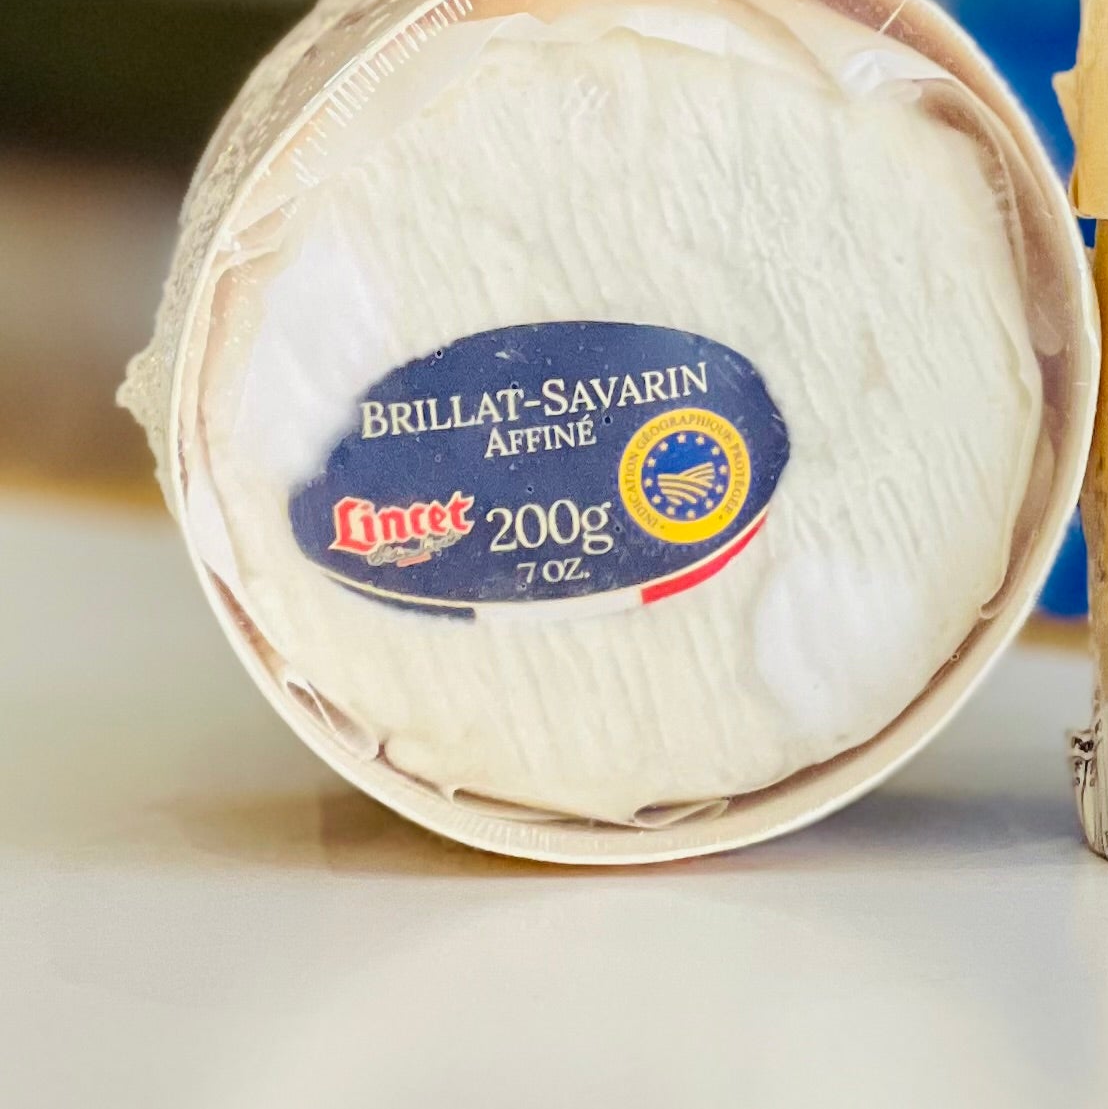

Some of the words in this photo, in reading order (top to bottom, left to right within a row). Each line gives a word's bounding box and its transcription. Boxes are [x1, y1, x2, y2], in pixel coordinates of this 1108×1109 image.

[360, 362, 708, 440] BRILLAT-SAVARIN
[484, 414, 597, 459] AFFINÉ
[625, 452, 658, 527] INDICATION
[328, 491, 475, 555] Lincet
[486, 499, 614, 555] 200g
[517, 562, 535, 583] 7
